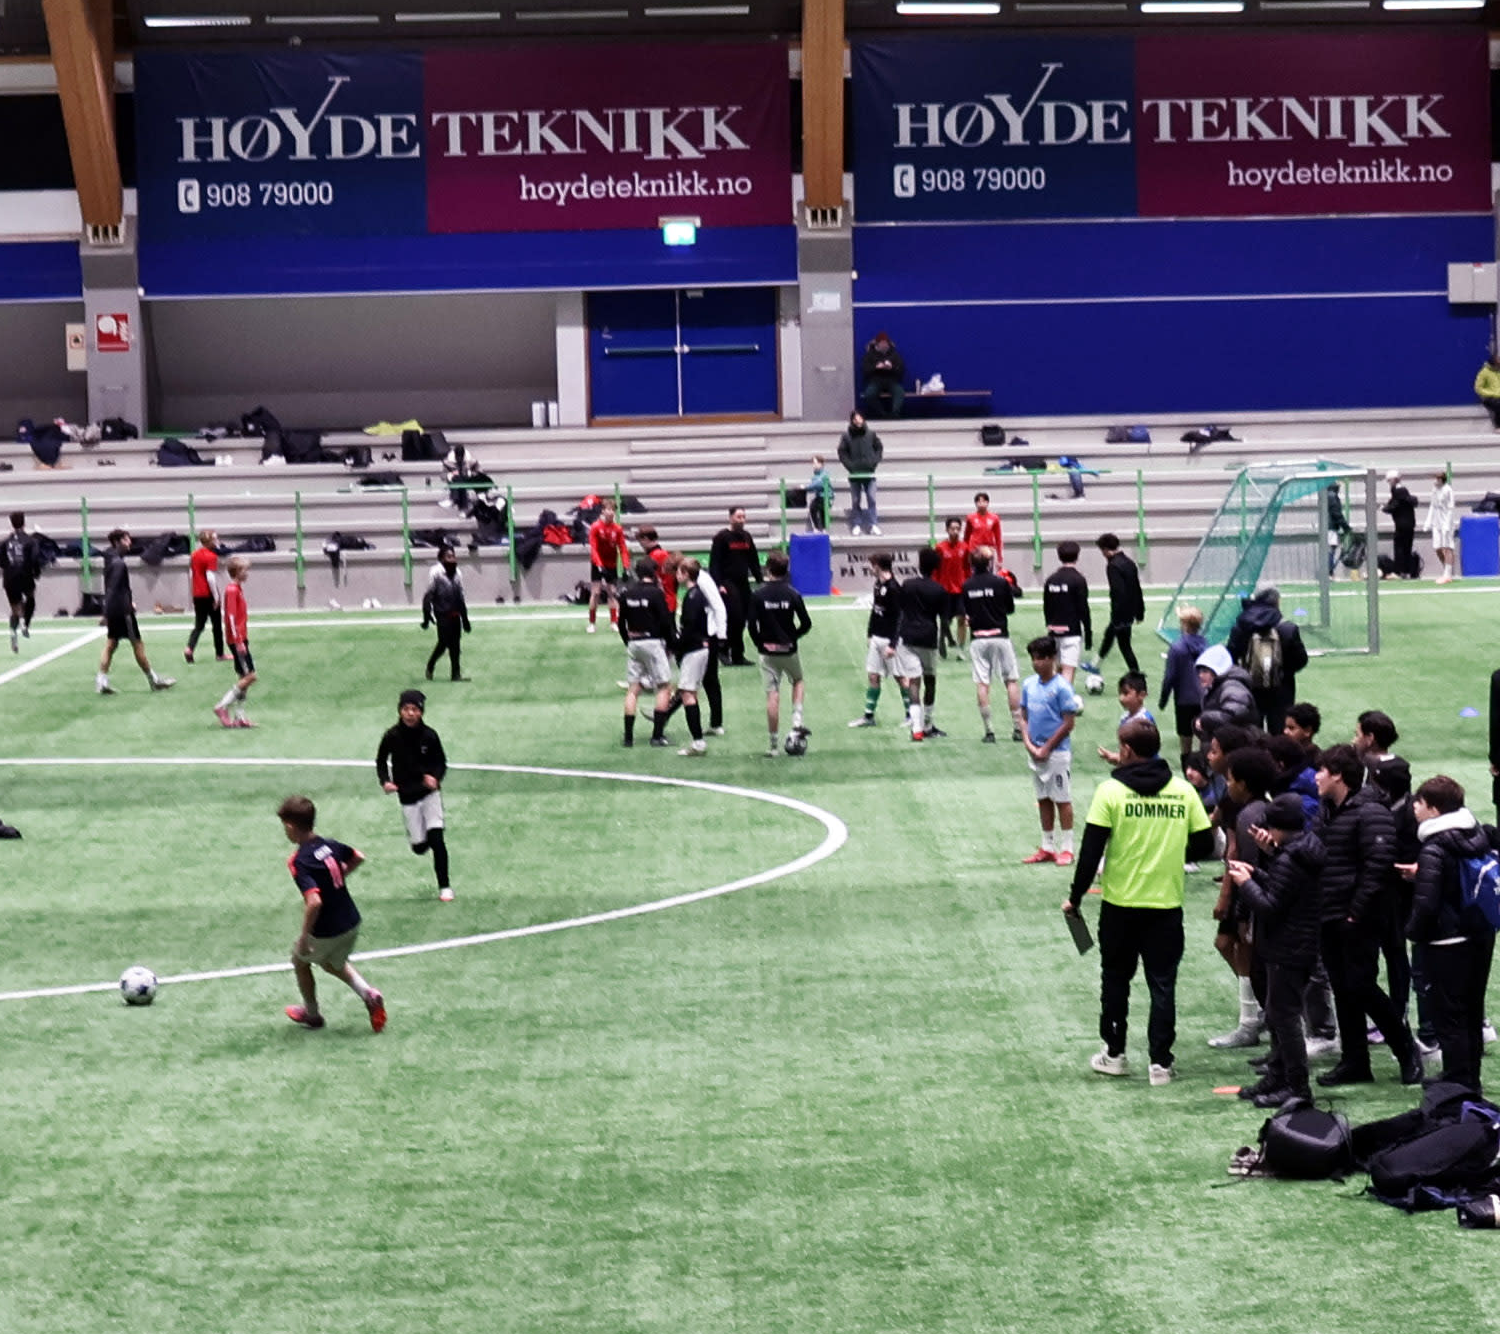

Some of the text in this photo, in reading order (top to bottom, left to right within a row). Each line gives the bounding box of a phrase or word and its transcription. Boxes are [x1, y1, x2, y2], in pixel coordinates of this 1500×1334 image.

[176, 76, 750, 162] HØYDE TEKNIKK
[893, 63, 1451, 148] HØYDE TEKNIKK
[520, 170, 753, 206] hoydeteknikk.no
[922, 166, 1046, 192] 908 79000
[1228, 157, 1453, 192] hoydeteknikk.no
[207, 181, 333, 207] 908 79000
[1125, 802, 1186, 819] DOMMER
